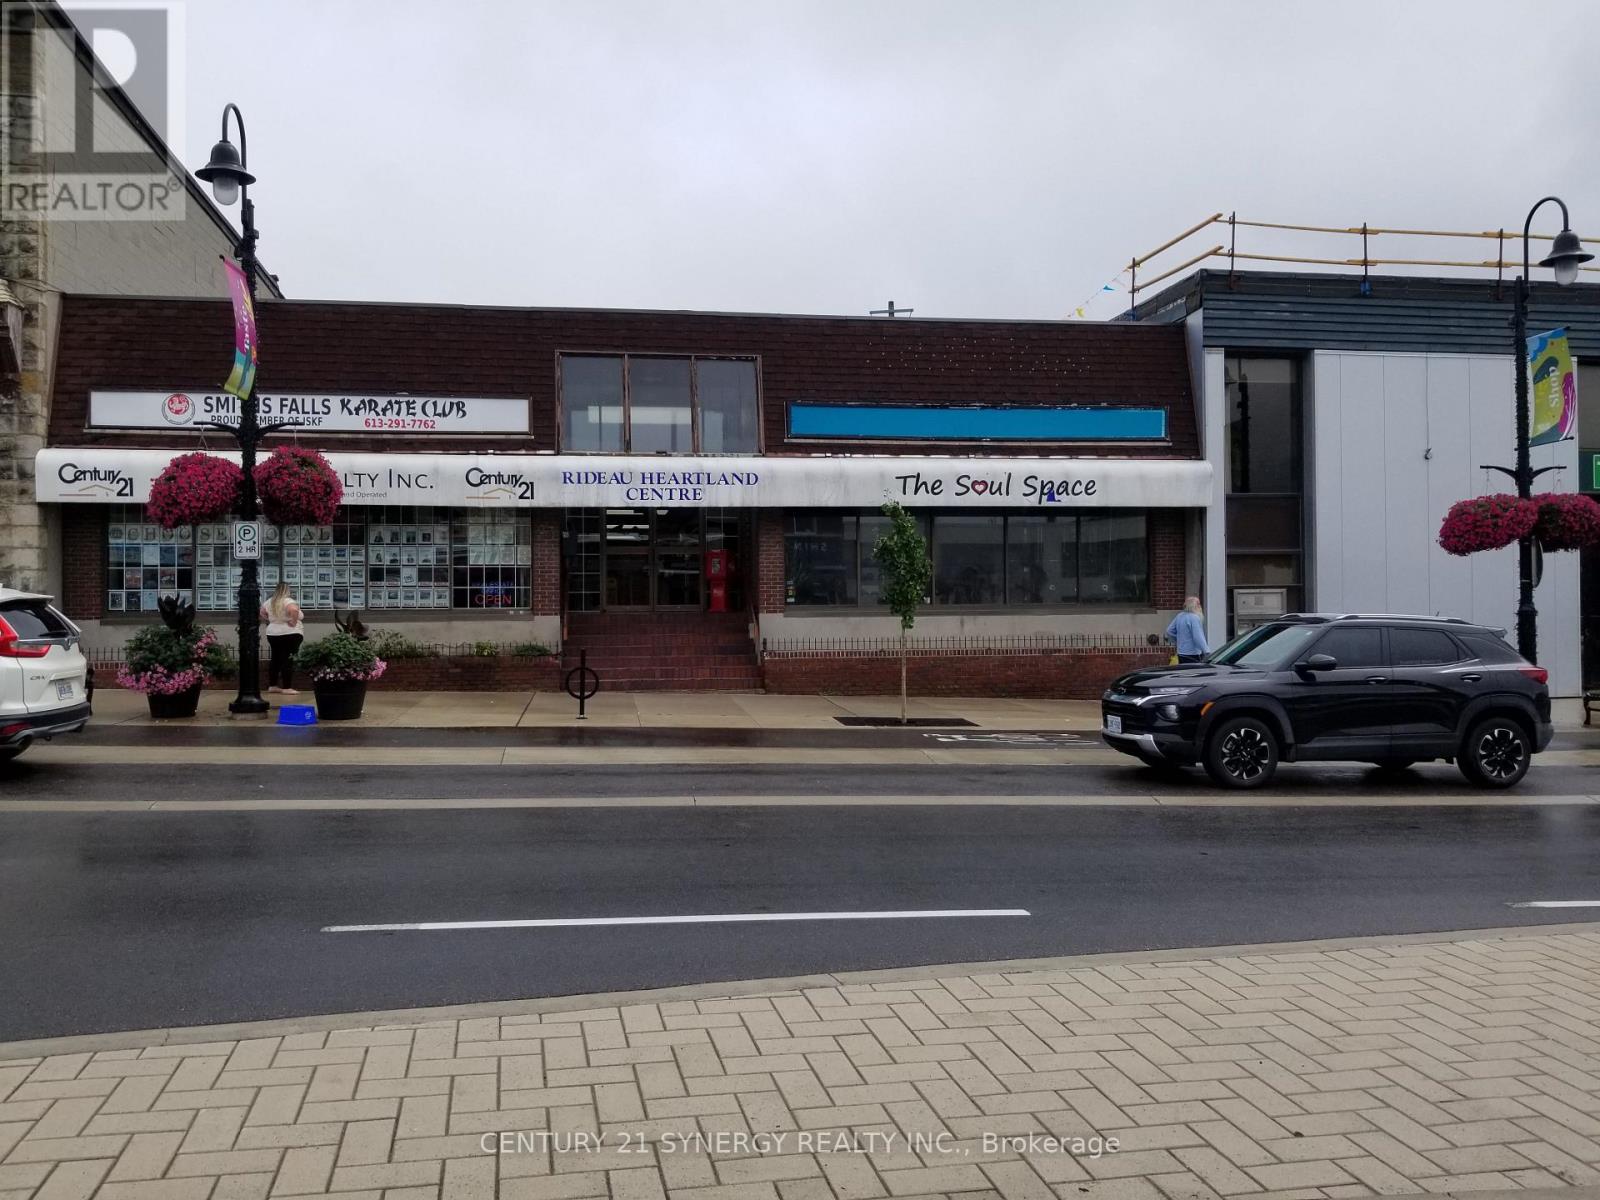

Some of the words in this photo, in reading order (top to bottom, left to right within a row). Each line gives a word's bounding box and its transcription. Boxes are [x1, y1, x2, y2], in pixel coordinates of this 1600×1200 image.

[204, 396, 272, 414] SMIS
[279, 397, 331, 415] FALLS
[340, 398, 417, 416] KARATE
[421, 399, 468, 418] CLUB
[364, 418, 436, 429] 613-291-7762
[58, 462, 122, 484] Century
[466, 467, 524, 488] Century
[562, 471, 633, 485] RIDEAU
[641, 471, 760, 485] HEARTLAND
[116, 477, 134, 497] 21
[356, 491, 388, 499] Operated
[518, 481, 535, 500] 21
[626, 487, 703, 501] CENTRE
[895, 472, 943, 496] The
[1023, 475, 1098, 505] Space
[238, 545, 243, 553] 2
[245, 545, 256, 553] HR
[474, 594, 512, 605] OPEN
